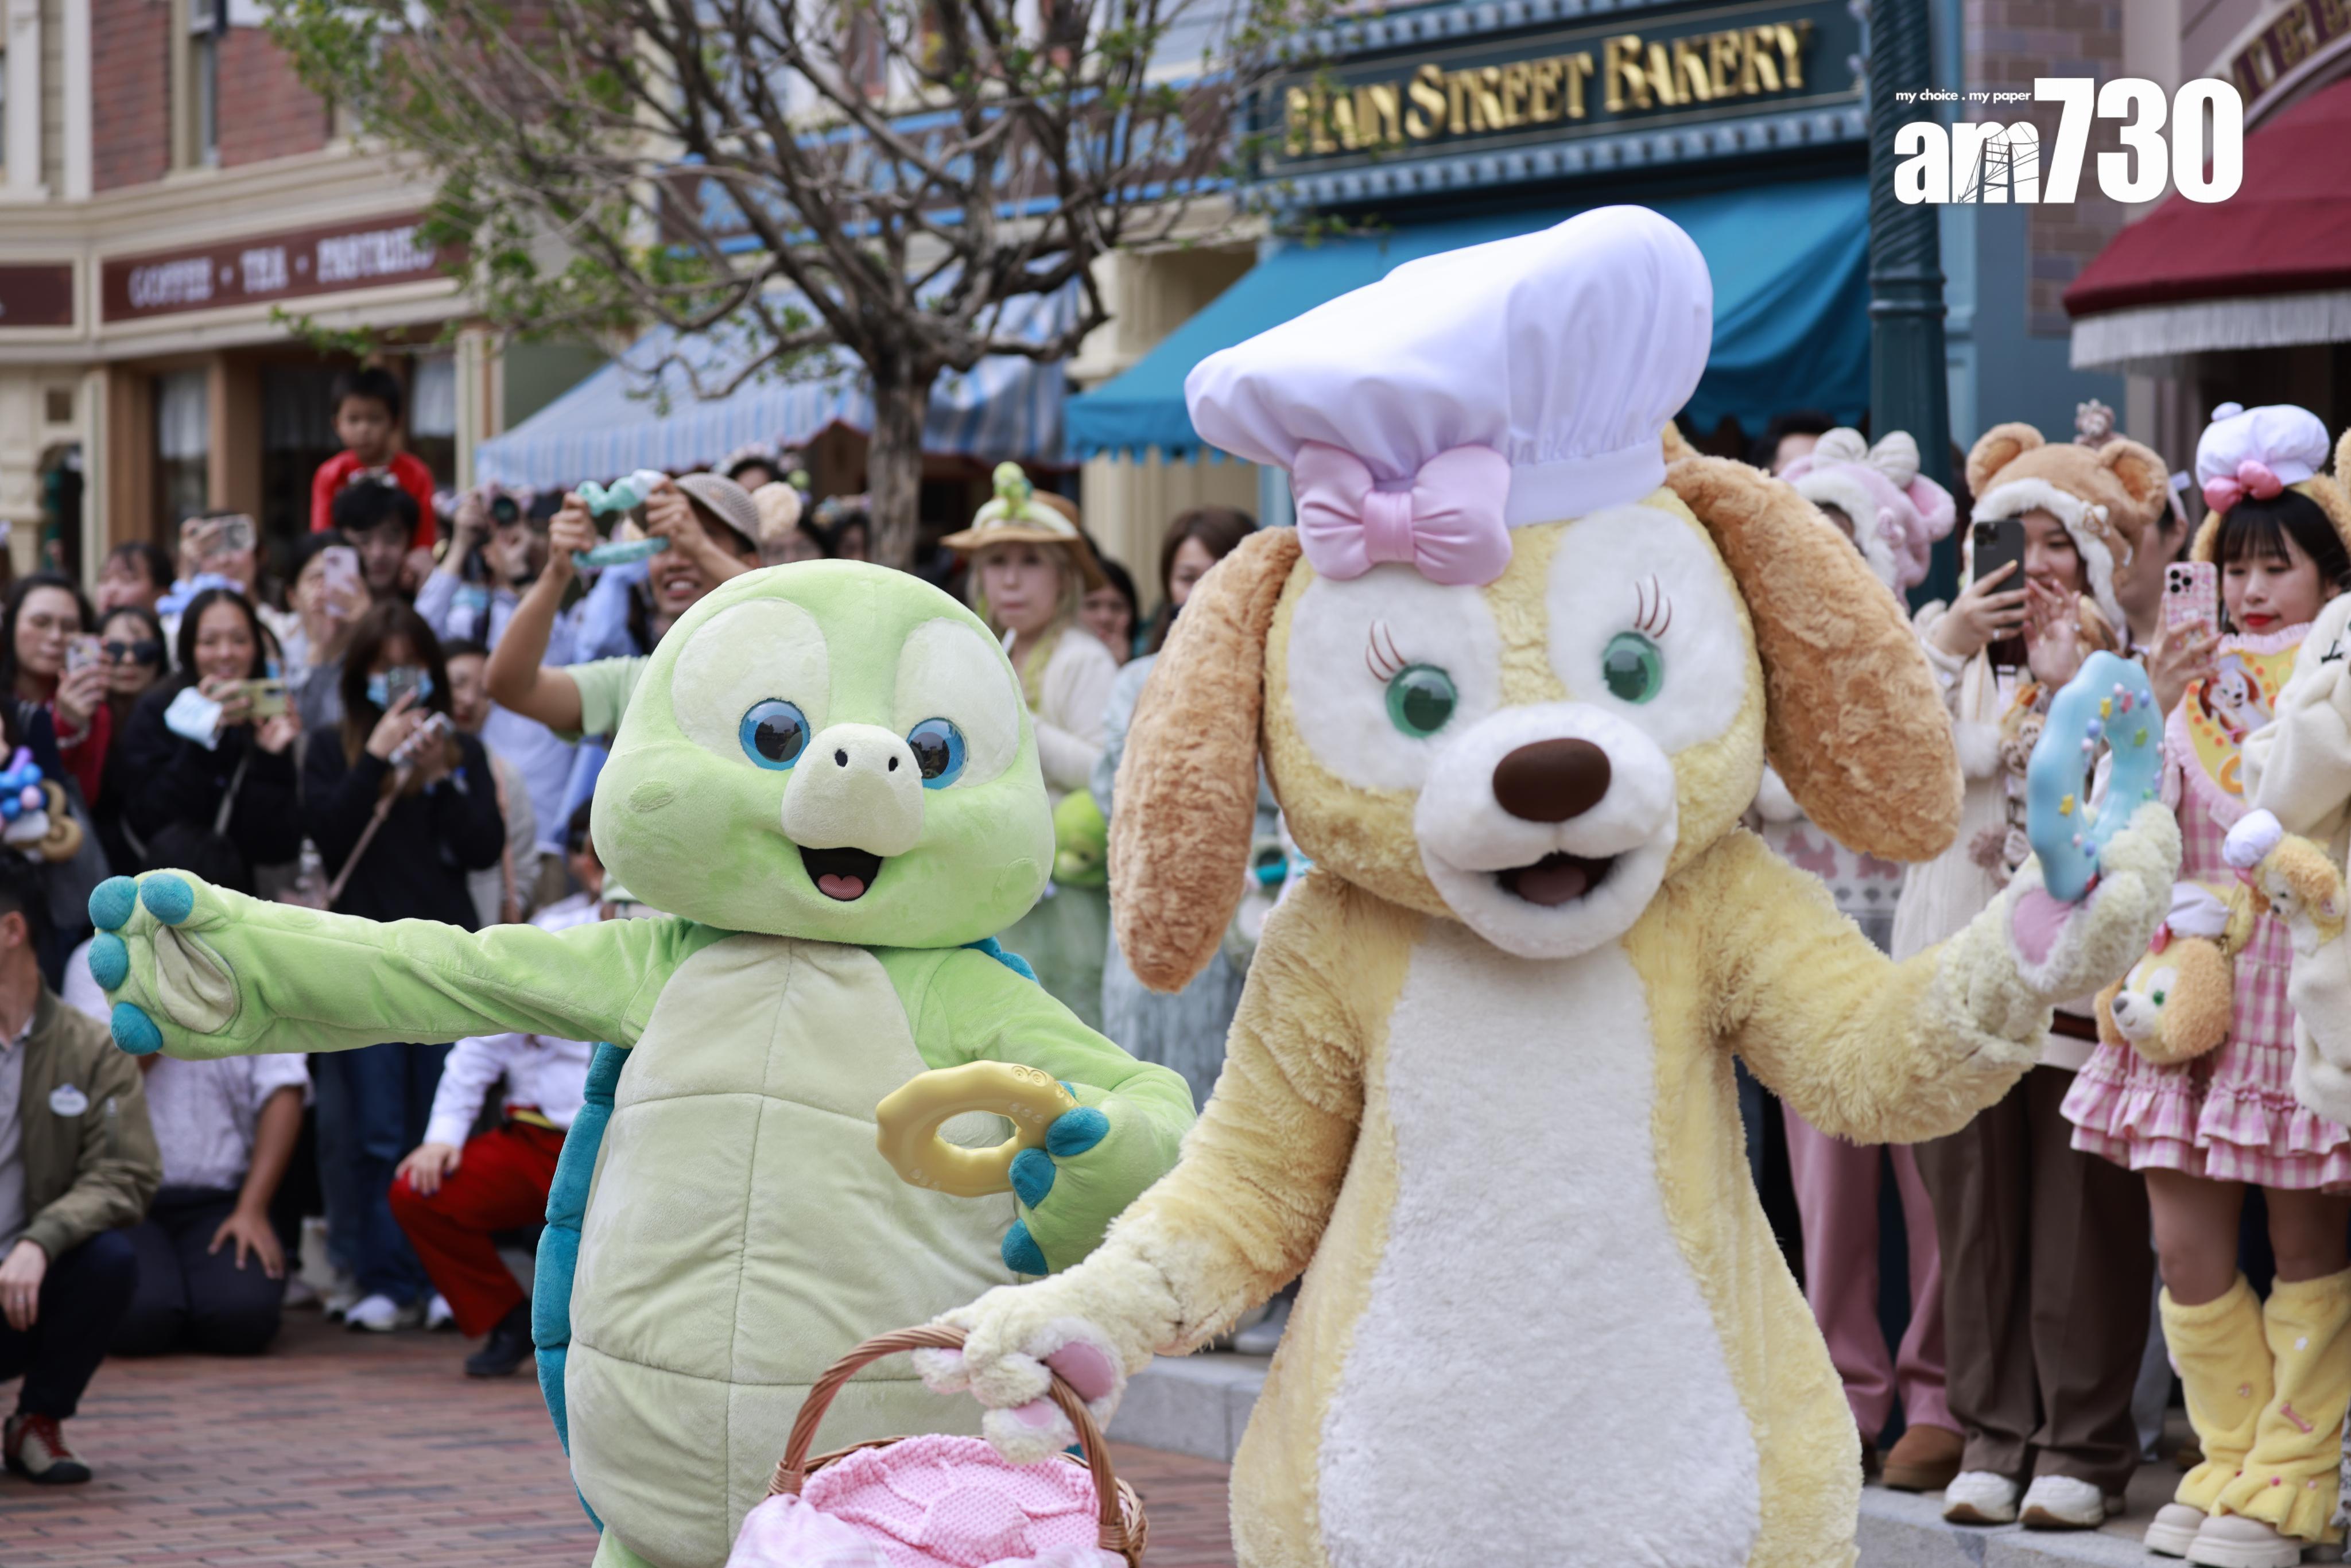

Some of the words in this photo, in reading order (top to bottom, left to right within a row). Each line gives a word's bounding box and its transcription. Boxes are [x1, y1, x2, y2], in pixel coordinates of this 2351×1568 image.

[1406, 52, 1594, 139] STREET
[1603, 18, 1812, 112] BAKERY
[128, 256, 213, 308] COFFEE
[239, 246, 289, 294] TEA
